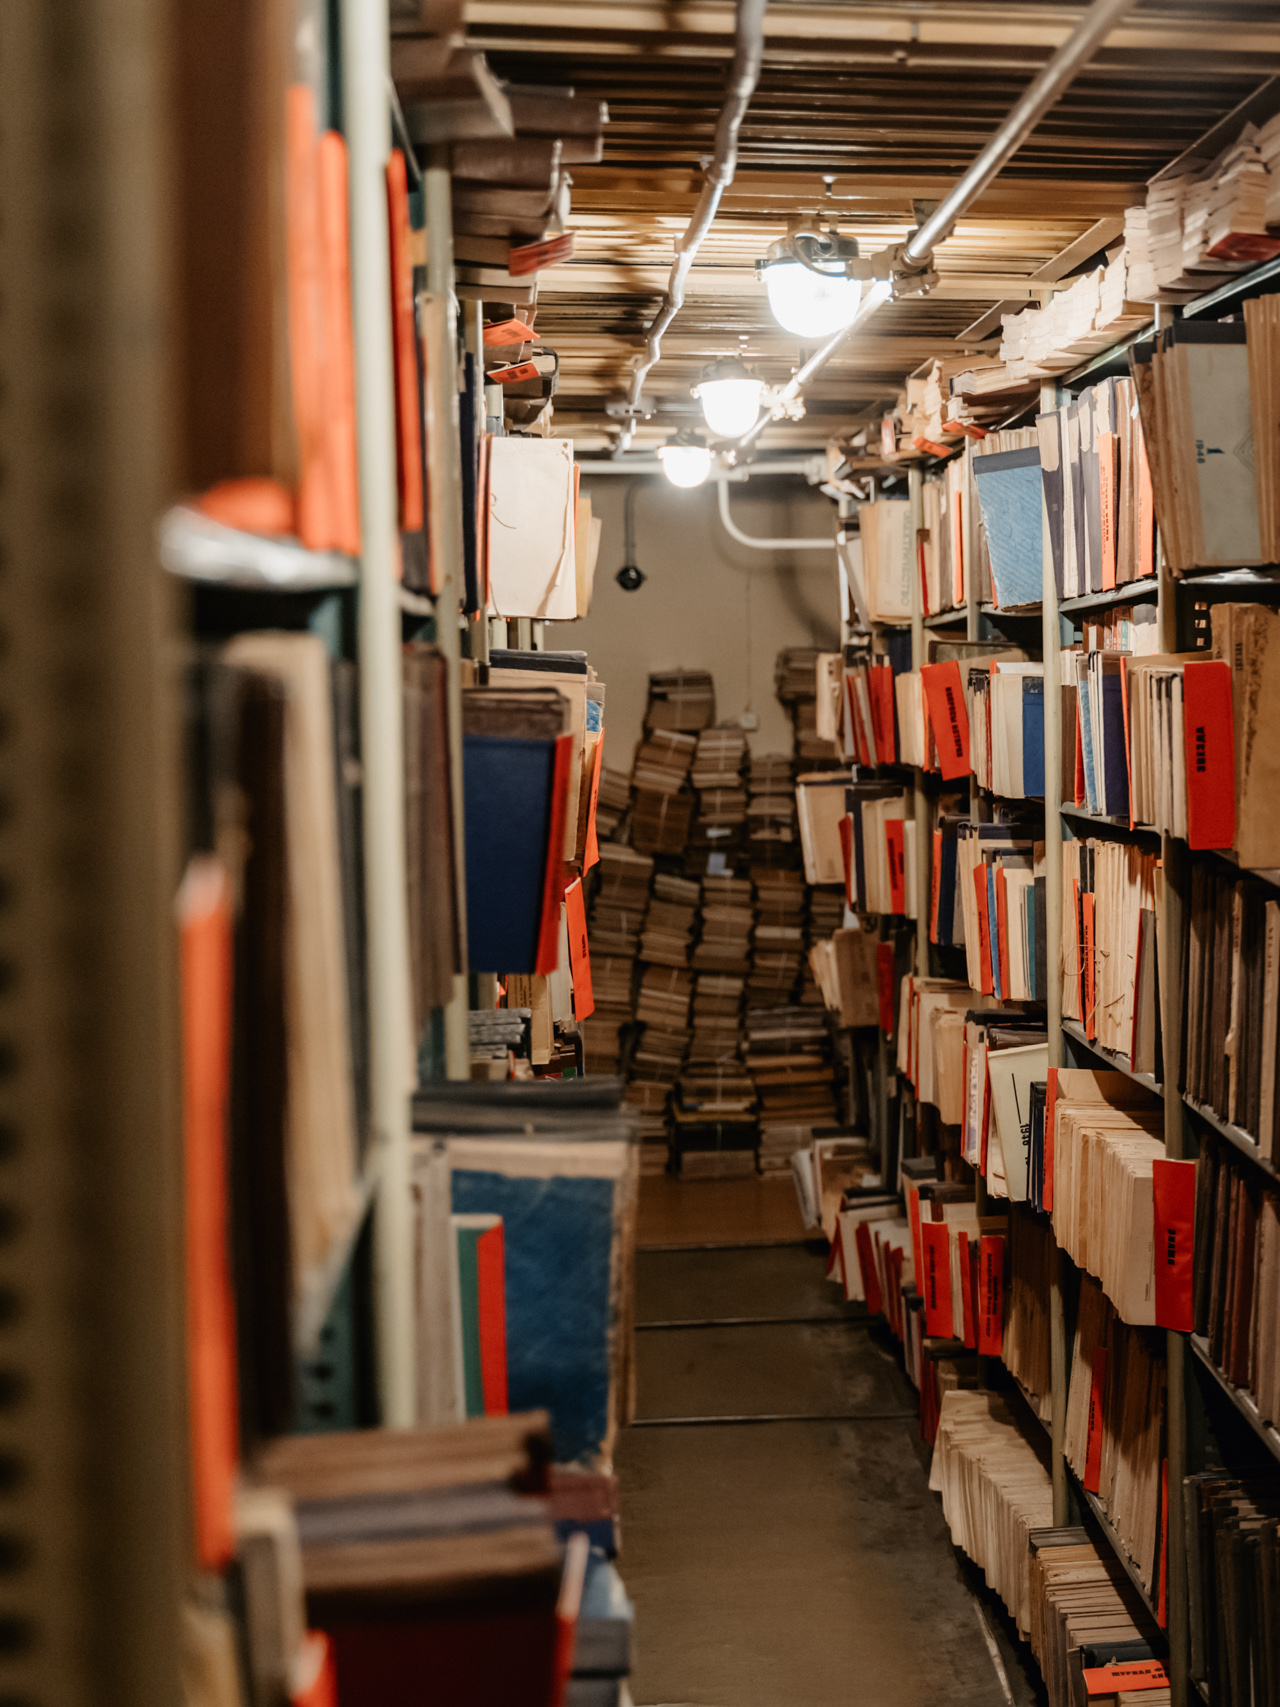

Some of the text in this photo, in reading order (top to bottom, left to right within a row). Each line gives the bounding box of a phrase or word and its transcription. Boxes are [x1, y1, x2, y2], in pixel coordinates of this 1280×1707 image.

[1196, 726, 1206, 773] ЗВЕЗДА
[1167, 1228, 1176, 1266] ЗНАМЯ
[1111, 1669, 1151, 1677] ЖУРНАЛ
